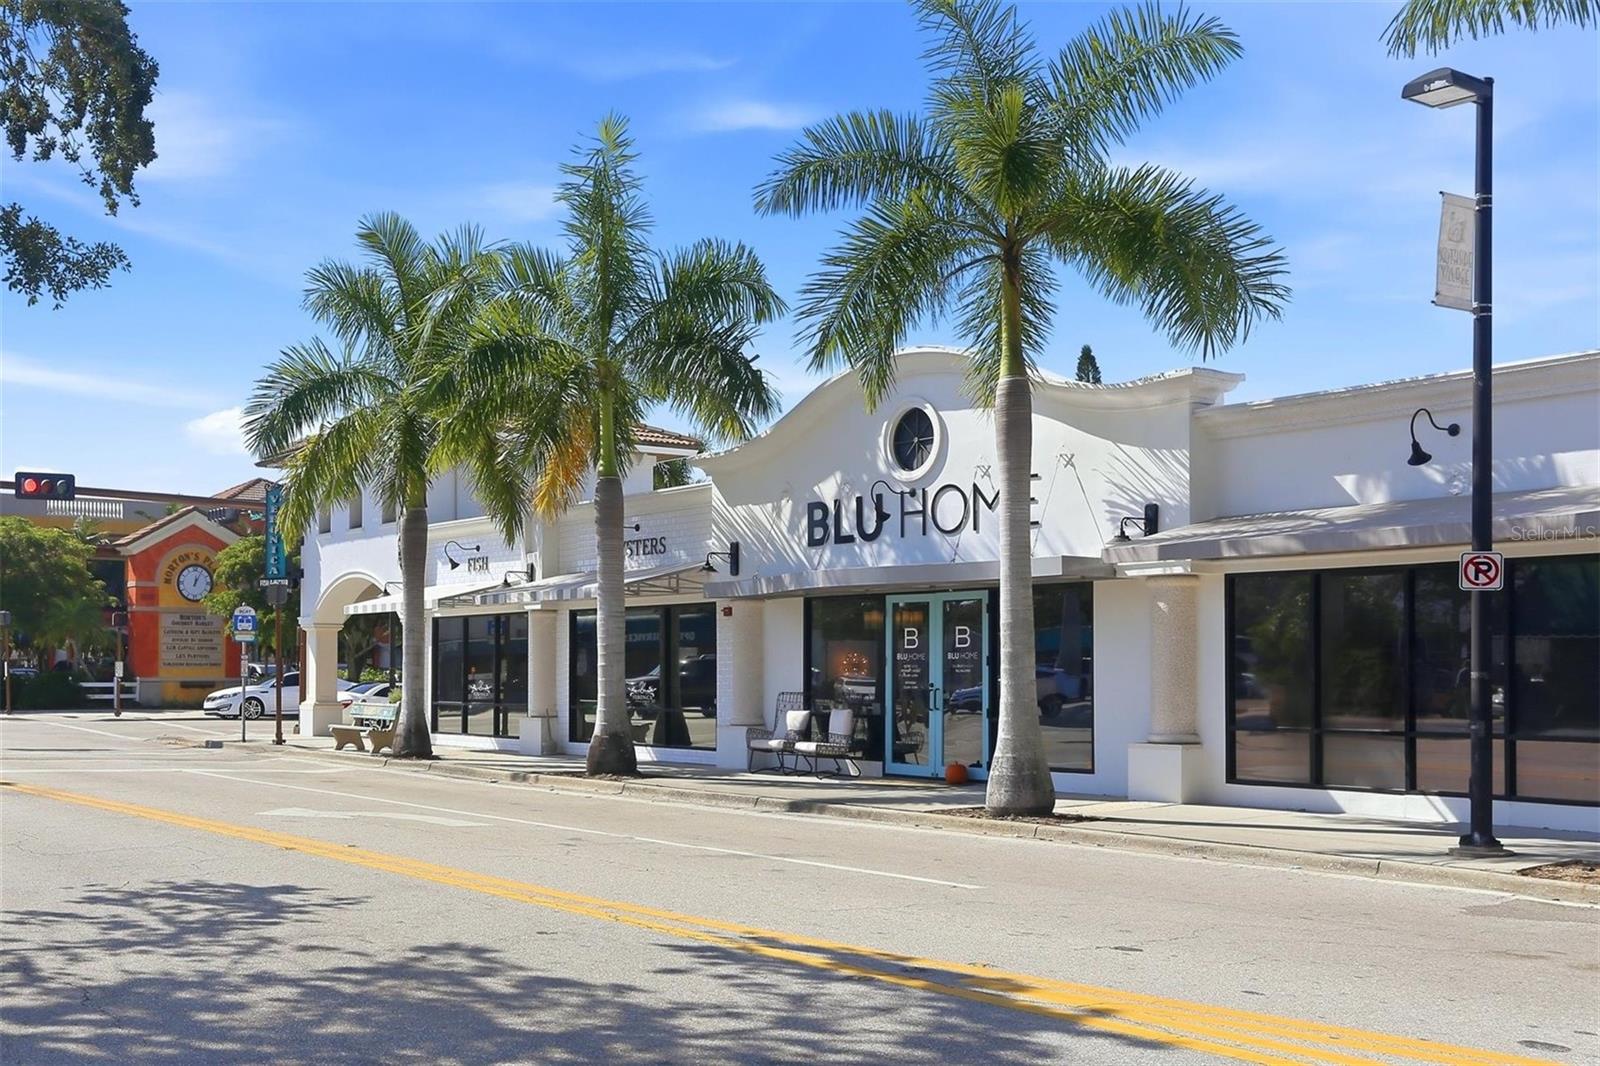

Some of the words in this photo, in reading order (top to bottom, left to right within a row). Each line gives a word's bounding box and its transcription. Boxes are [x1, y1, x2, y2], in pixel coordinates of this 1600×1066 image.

[807, 493, 883, 547] BLU
[623, 536, 667, 558] STERS
[467, 556, 489, 572] FISH
[904, 627, 919, 649] B
[955, 625, 971, 648] B
[947, 652, 960, 660] BLU
